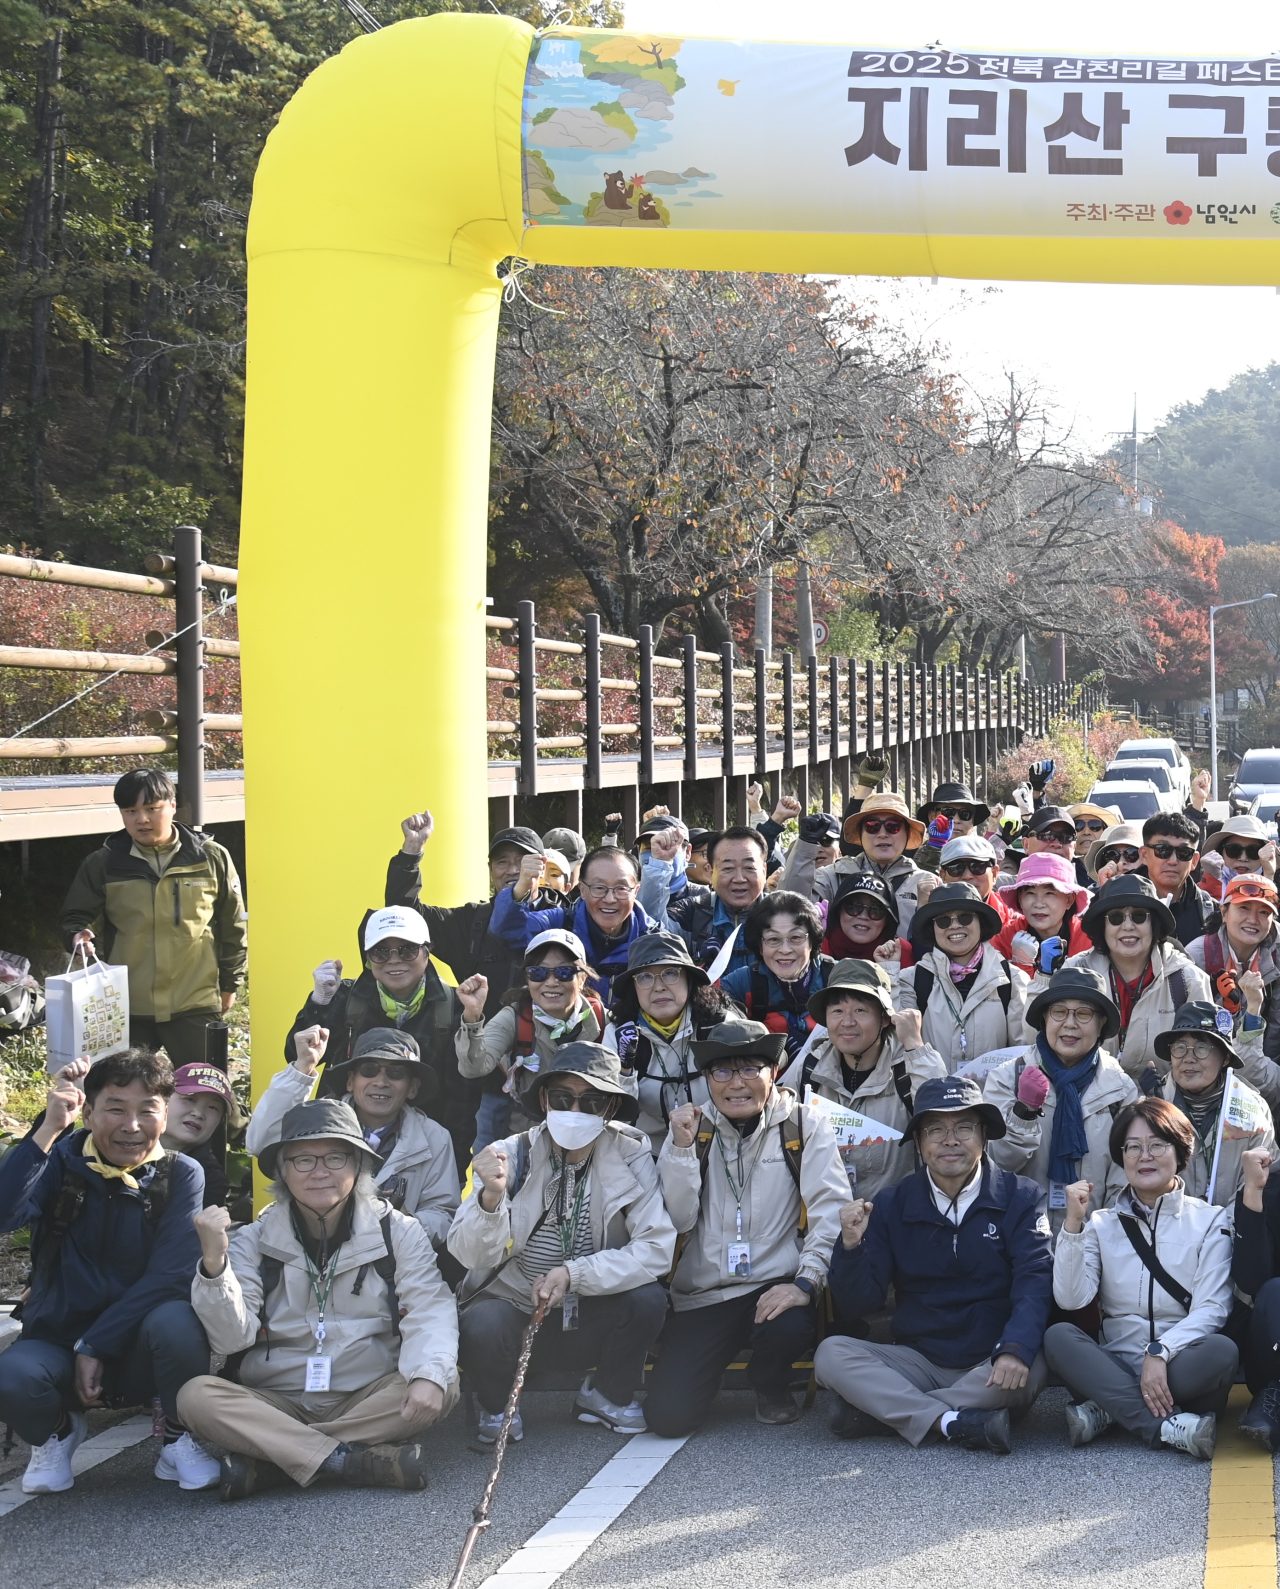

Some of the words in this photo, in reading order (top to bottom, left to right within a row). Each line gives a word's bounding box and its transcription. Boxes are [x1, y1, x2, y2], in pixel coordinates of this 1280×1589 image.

[861, 53, 969, 75] 2025
[979, 57, 1043, 79] 전북
[1053, 58, 1186, 81] 삼천리길
[844, 86, 1130, 175] 지리산
[1066, 203, 1156, 222] 주최·주관
[1196, 204, 1256, 224] 남원시
